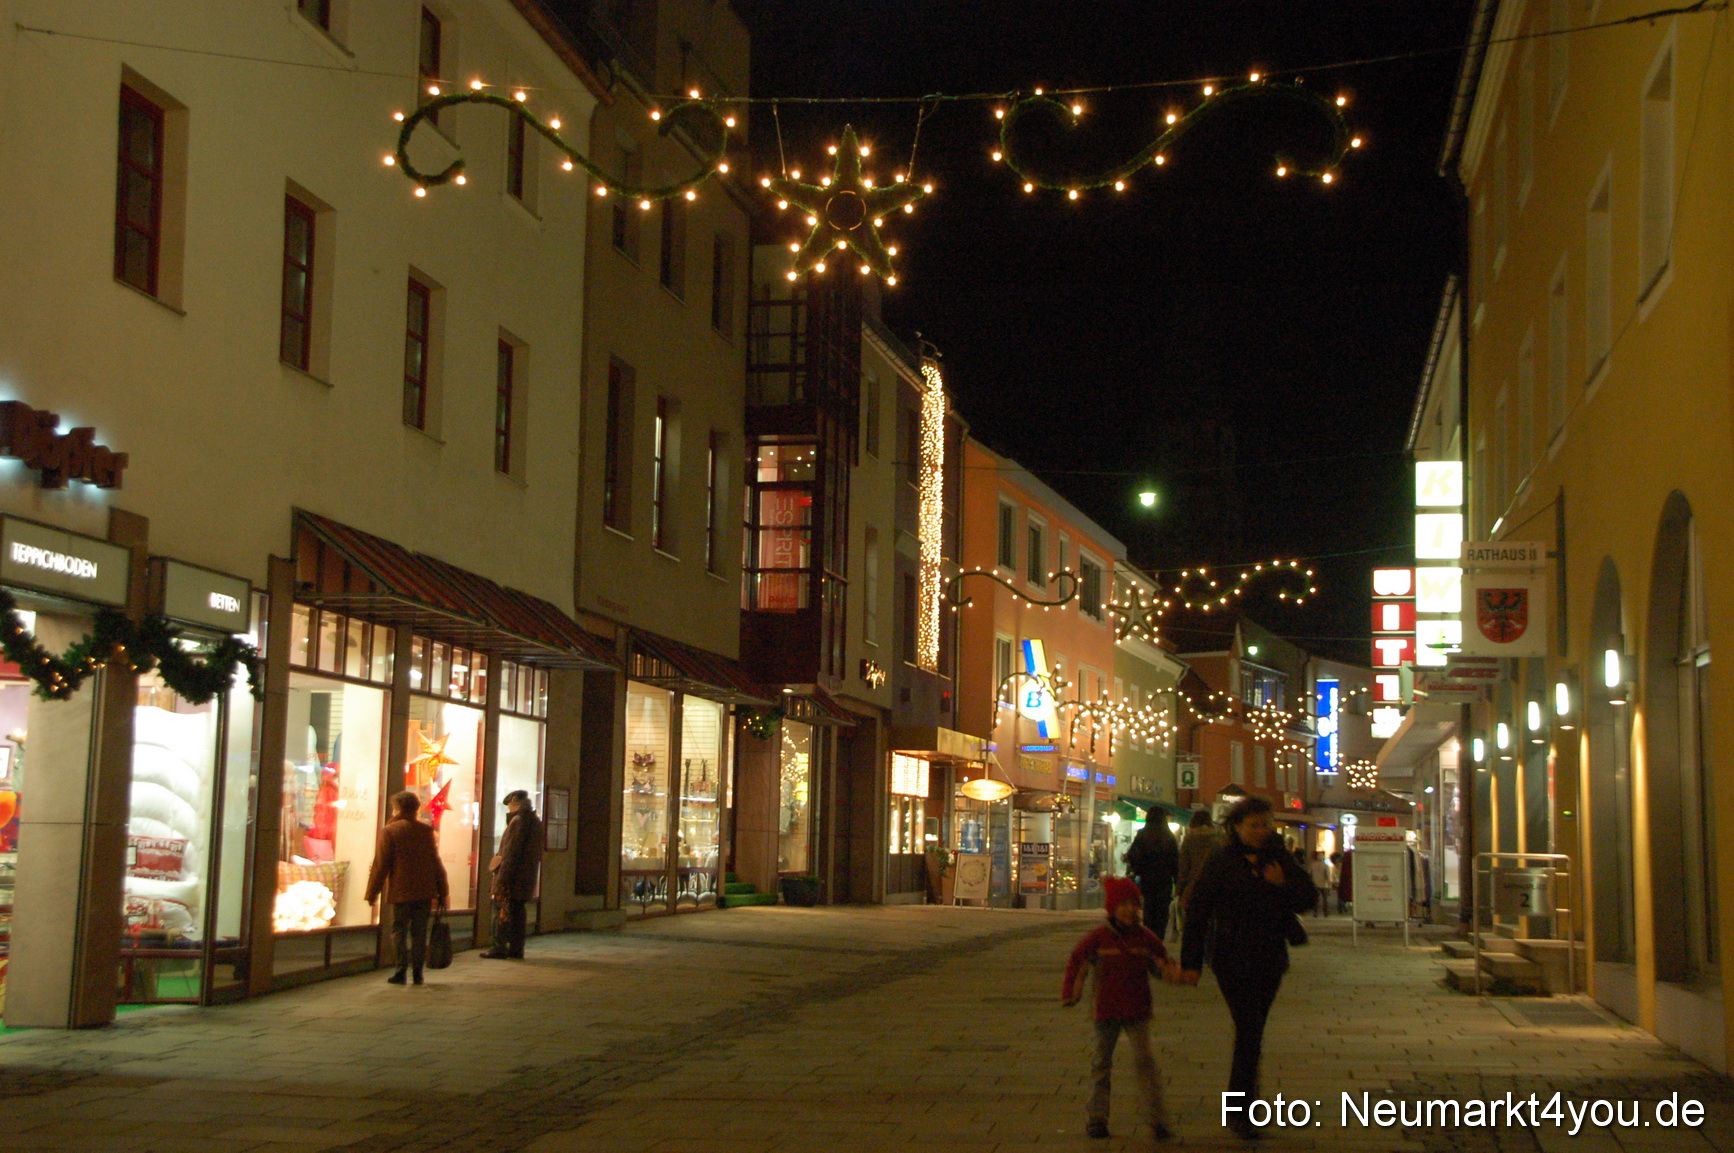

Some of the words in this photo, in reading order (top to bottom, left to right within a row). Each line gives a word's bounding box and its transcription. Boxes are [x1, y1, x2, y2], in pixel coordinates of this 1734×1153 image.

[11, 541, 98, 579] TEPPICHBODEN
[1466, 548, 1526, 561] RATHAUS
[209, 591, 241, 613] BETTEN
[1519, 892, 1530, 908] 2
